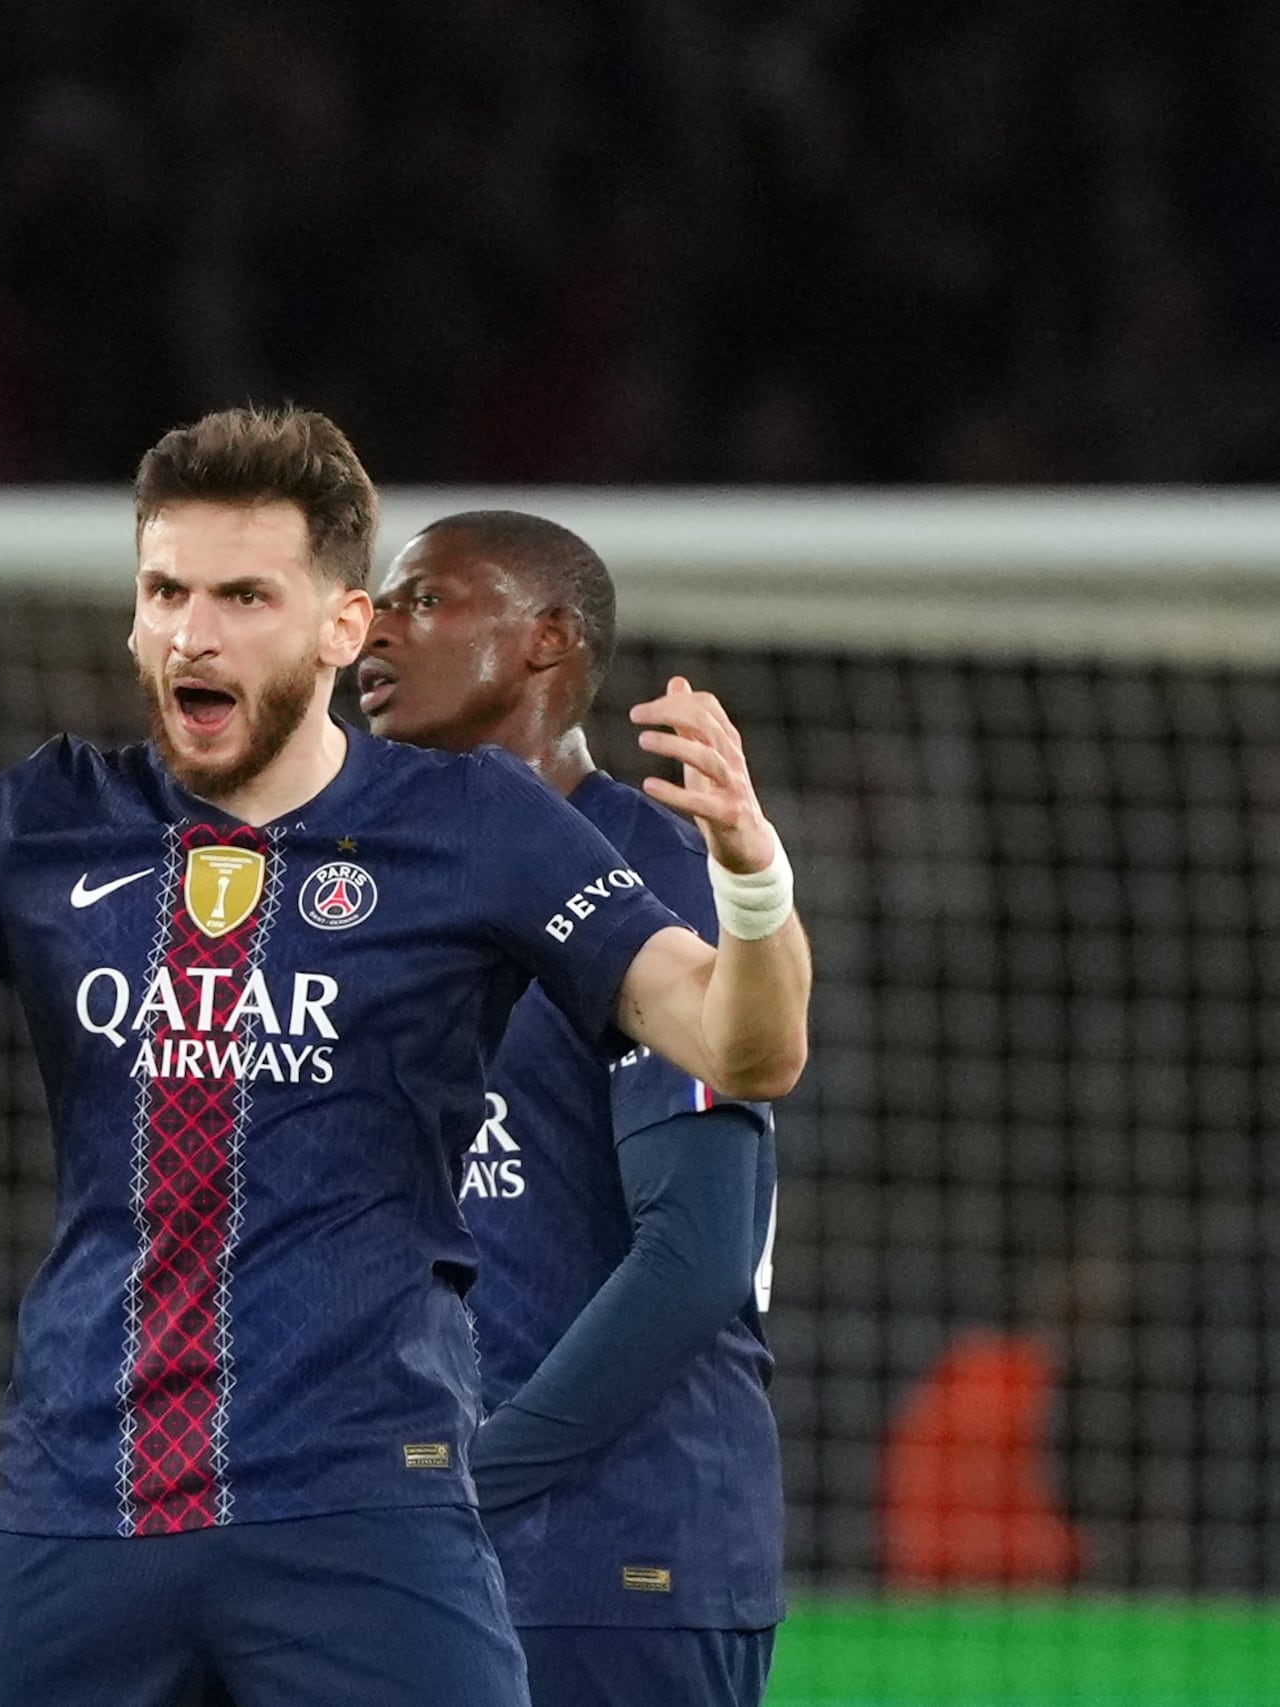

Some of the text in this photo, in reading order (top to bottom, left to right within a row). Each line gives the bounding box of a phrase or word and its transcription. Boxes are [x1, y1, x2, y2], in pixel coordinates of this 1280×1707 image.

[316, 866, 367, 886] PARIS
[76, 967, 340, 1049] QATAR
[129, 1039, 334, 1084] AIRWAYS
[468, 1092, 522, 1154] R
